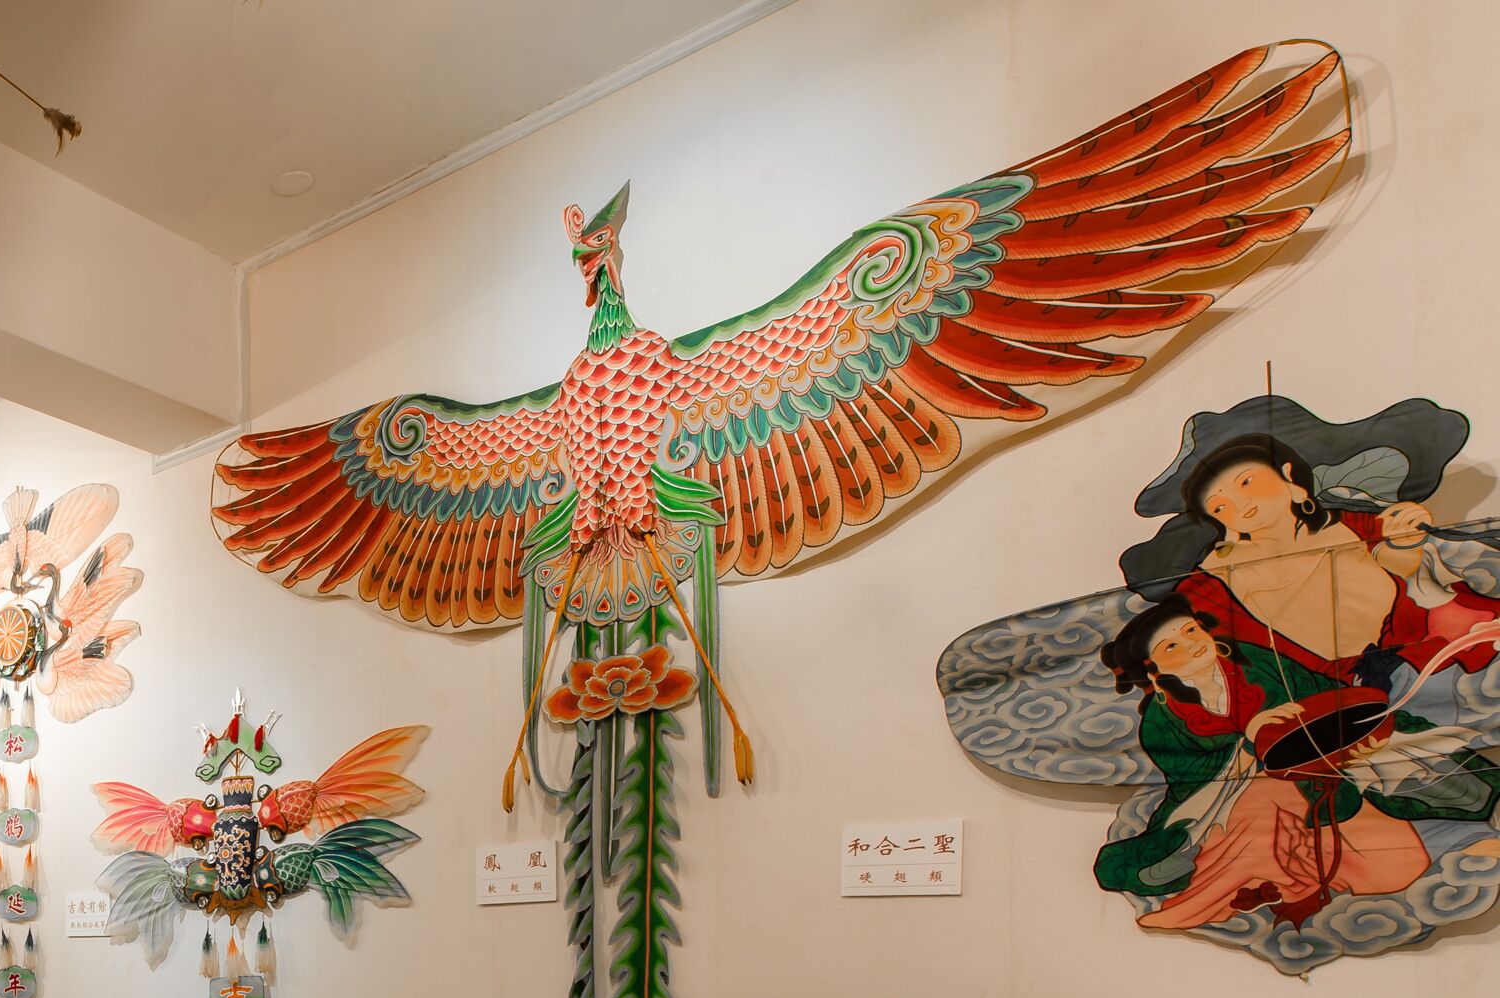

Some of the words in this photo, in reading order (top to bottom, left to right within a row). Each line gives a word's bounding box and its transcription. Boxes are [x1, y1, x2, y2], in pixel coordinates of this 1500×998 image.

[4, 732, 25, 757] 松
[4, 813, 25, 841] 鶴
[847, 833, 956, 858] 和合二聖
[483, 850, 547, 872] 鳳凰
[6, 891, 26, 916] 延
[67, 899, 107, 915] 吉慶有餘
[4, 972, 26, 998] 年
